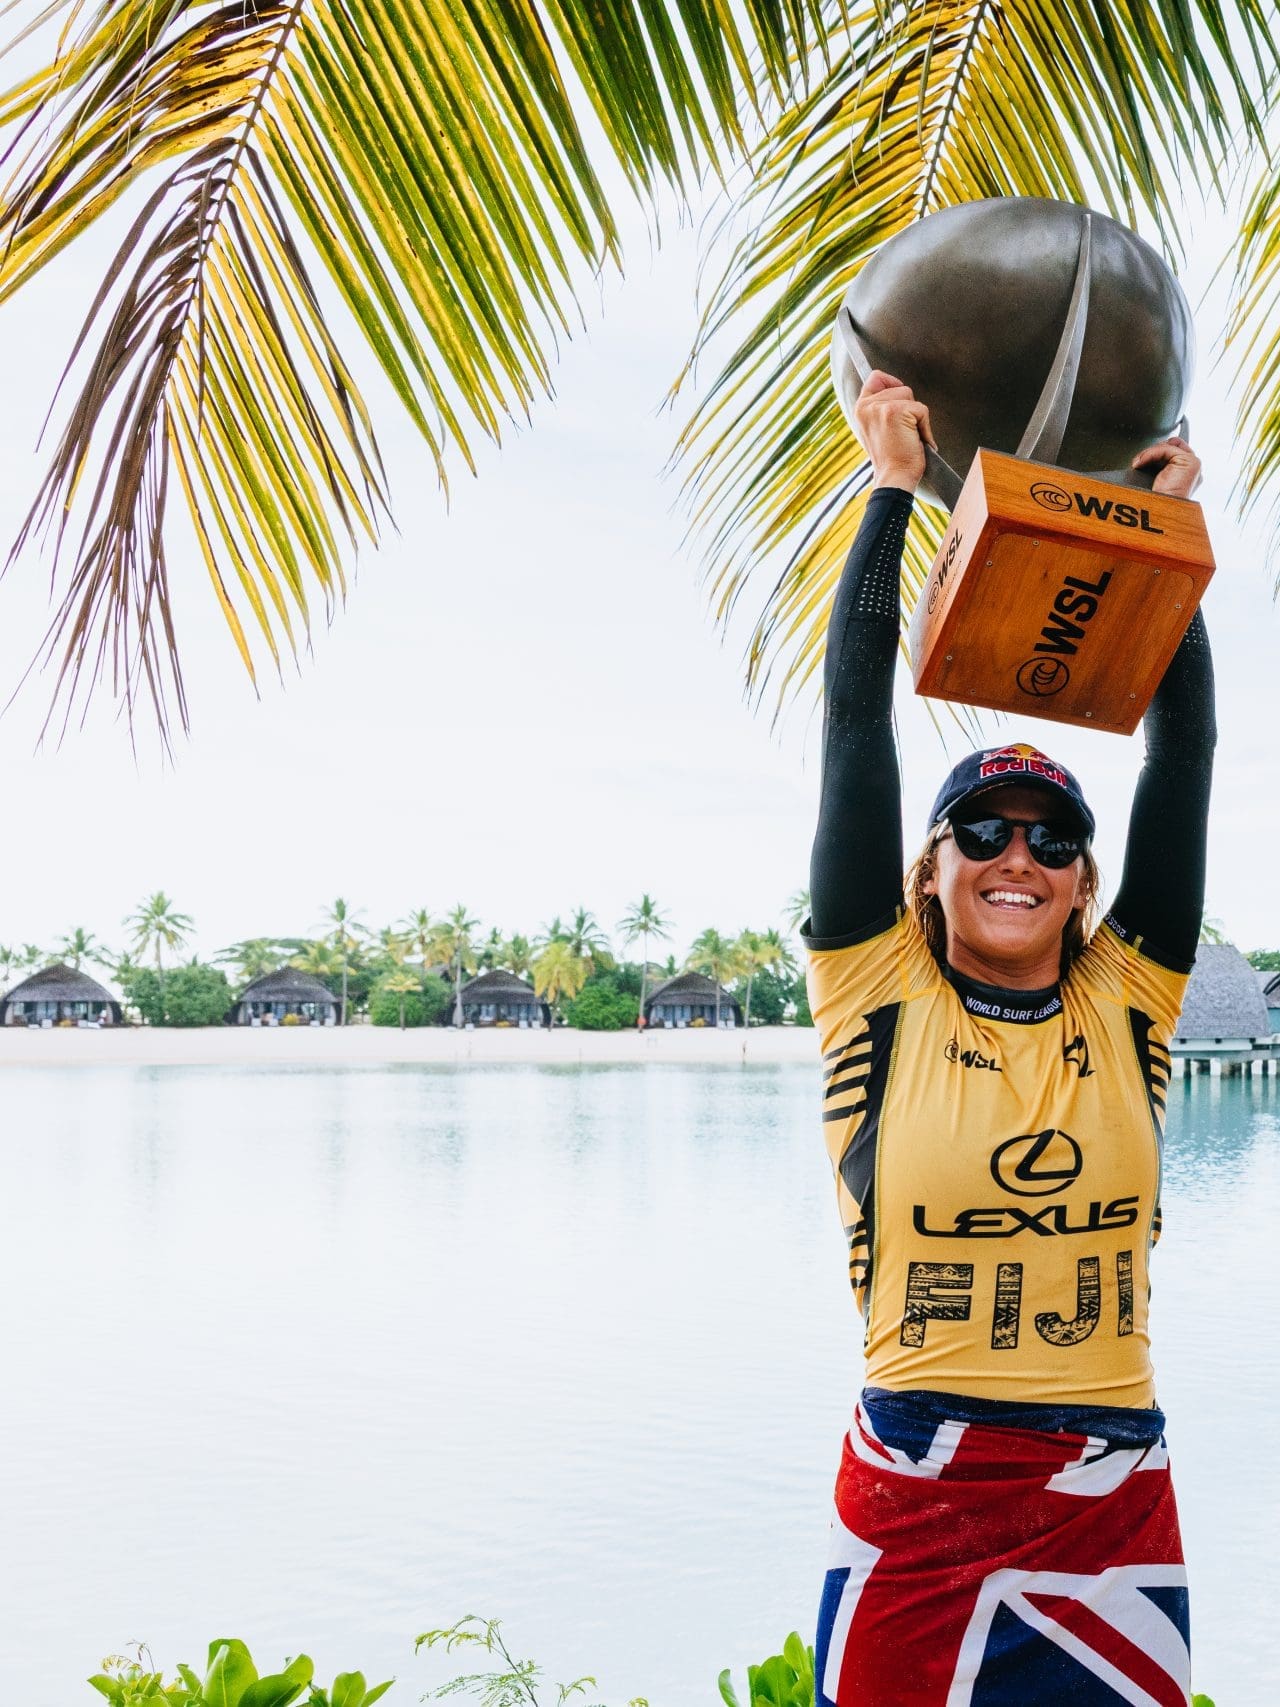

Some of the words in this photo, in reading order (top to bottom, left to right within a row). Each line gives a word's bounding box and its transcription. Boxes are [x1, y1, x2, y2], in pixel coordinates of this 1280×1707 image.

[1073, 492, 1164, 534] WSL
[1034, 568, 1113, 656] WSL
[979, 758, 1024, 779] Red
[1028, 758, 1068, 789] Bull
[966, 995, 1000, 1017] WORLD
[1002, 1007, 1033, 1021] SURF
[1034, 997, 1062, 1020] LEAGUE
[913, 1196, 1139, 1238] LEXUS
[900, 1250, 1134, 1350] FIJI
